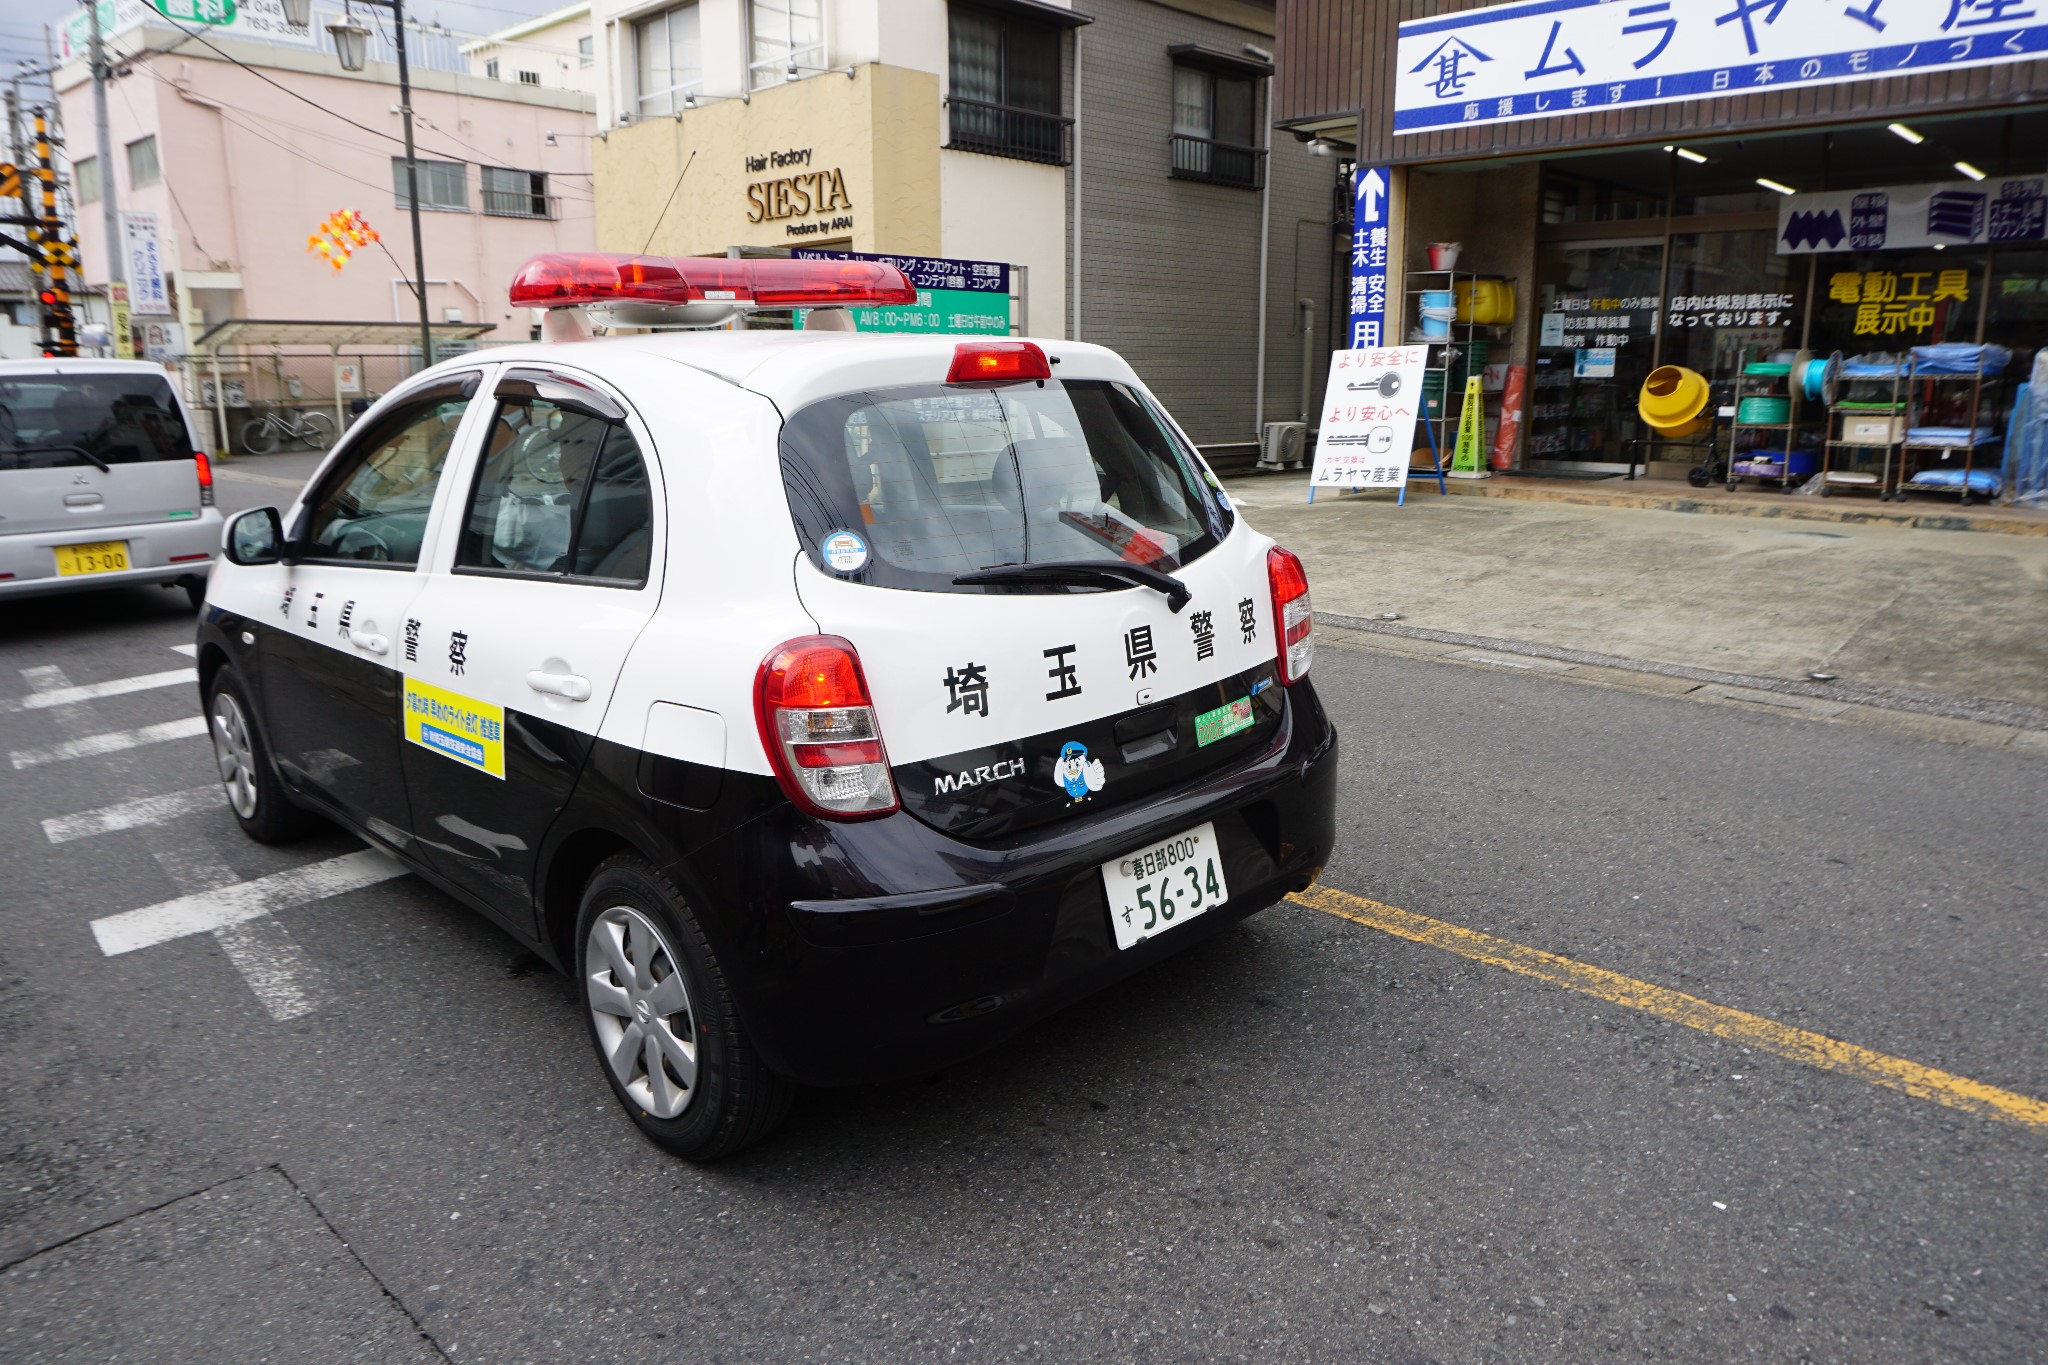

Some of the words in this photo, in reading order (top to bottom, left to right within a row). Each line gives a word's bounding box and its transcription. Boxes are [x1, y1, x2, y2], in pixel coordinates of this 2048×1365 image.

[745, 154, 769, 173] Hair
[770, 148, 812, 168] Factory
[746, 167, 852, 224] SIESTA
[786, 223, 818, 236] Produce
[819, 220, 830, 234] by
[831, 215, 853, 230] ARAI
[1829, 269, 1970, 304] 電動工具
[1670, 293, 1794, 311] 店内は税別表示に
[1668, 311, 1792, 327] なっております。
[1853, 303, 1936, 336] 展示中
[1351, 320, 1380, 350] 用
[1338, 350, 1420, 369] より安全に
[1328, 405, 1411, 423] より安心へ
[1318, 466, 1401, 483] ムラヤマ産業
[943, 596, 1257, 718] 埼玉県警察
[934, 757, 1026, 796] MARCH
[1121, 905, 1134, 928] す
[1136, 857, 1220, 930] 56-34
